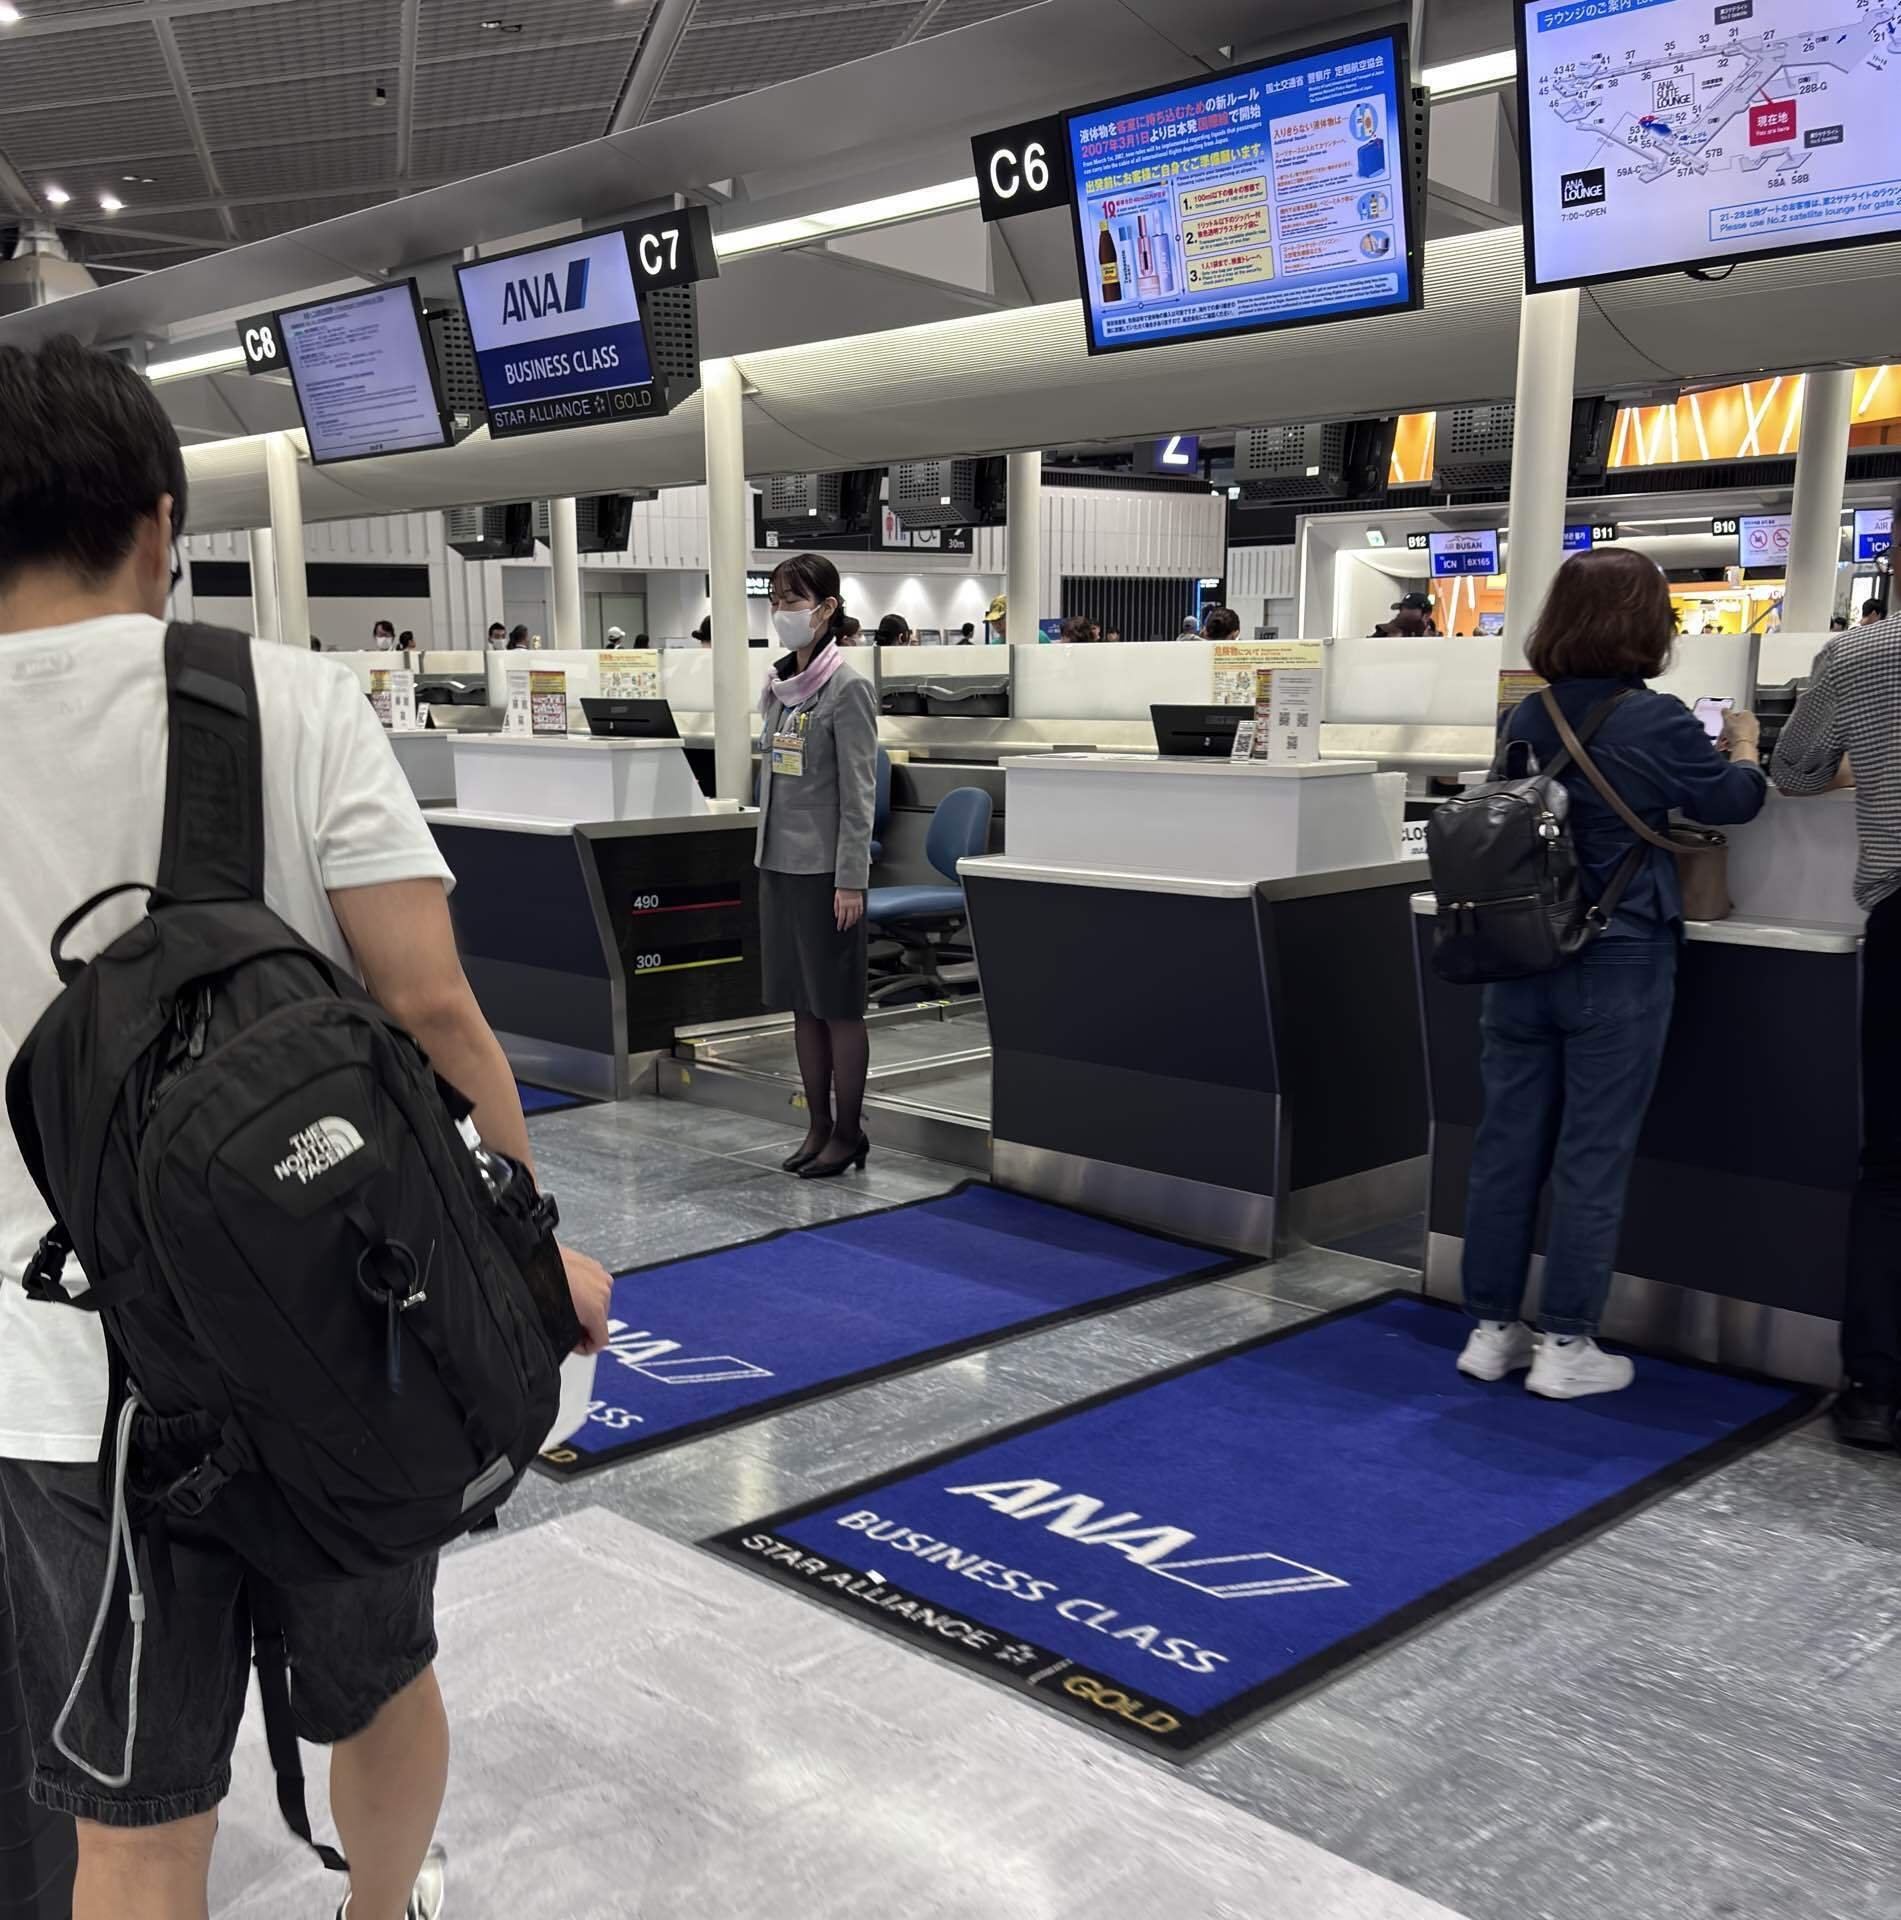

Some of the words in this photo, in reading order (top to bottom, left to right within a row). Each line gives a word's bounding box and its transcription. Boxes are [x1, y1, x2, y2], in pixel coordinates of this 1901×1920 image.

[1729, 27, 1739, 37] 31
[1763, 30, 1776, 40] 27
[1874, 32, 1885, 42] 21
[1699, 34, 1710, 44] 33
[1665, 41, 1676, 51] 35
[1600, 56, 1611, 65] 41
[1625, 50, 1636, 60] 37
[1565, 64, 1576, 73] 42
[1717, 58, 1729, 68] 32
[1554, 66, 1564, 75] 43
[1673, 64, 1684, 74] 34
[1539, 76, 1548, 84] 44
[1641, 72, 1652, 81] 36
[1608, 78, 1619, 88] 38
[1539, 87, 1549, 96] 45
[1578, 90, 1588, 99] 47
[1549, 99, 1560, 109] 46
[1692, 104, 1702, 114] 51
[1676, 112, 1687, 121] 52
[1756, 112, 1790, 127] 現在地
[1629, 125, 1641, 134] 53
[1627, 135, 1639, 144] 54
[1705, 148, 1723, 158] 57B
[990, 142, 1049, 199] C6
[1617, 165, 1642, 177] 59A-C
[1677, 168, 1694, 177] 57A
[1565, 179, 1584, 191] ANA
[1768, 178, 1785, 188] 58A
[1791, 173, 1810, 184] 58B
[1563, 185, 1603, 202] LOUNGE
[1183, 198, 1193, 210] 1.
[1720, 221, 1748, 233] Please
[1750, 219, 1765, 228] use
[1767, 214, 1787, 225] No.2
[1789, 210, 1823, 222] satellite
[1825, 205, 1856, 219] lounge
[1858, 201, 1871, 211] for
[1874, 200, 1895, 210] gate
[1185, 232, 1197, 244] 2.
[639, 229, 680, 276] C7
[1189, 269, 1201, 282] 3.
[502, 272, 563, 326] ANA
[244, 326, 277, 363] C8
[504, 353, 571, 385] BUSINESS
[572, 344, 620, 373] CLASS
[495, 408, 527, 428] STAR
[529, 399, 592, 422] ALLIANCE
[614, 390, 652, 410] GOLD
[1713, 519, 1736, 534] B10
[1874, 521, 1889, 531] AIR
[1592, 526, 1613, 540] B11
[948, 538, 965, 549] 30m
[1408, 536, 1427, 548] B12
[1456, 541, 1482, 550] BUSAN
[1443, 560, 1457, 568] ICN
[1467, 558, 1490, 567] BX165
[633, 894, 659, 909] 490
[636, 953, 661, 969] 300
[289, 1121, 322, 1152] THE
[273, 1135, 332, 1181] NORTH
[297, 1150, 340, 1185] FACE
[603, 1319, 682, 1363] NA
[944, 1478, 1197, 1566] ANA
[836, 1510, 1059, 1601] BUSINESS
[1055, 1598, 1231, 1673] CLASS
[741, 1533, 830, 1576] STAR
[820, 1572, 999, 1649] ALLIANCE
[1062, 1674, 1182, 1734] GOLD
